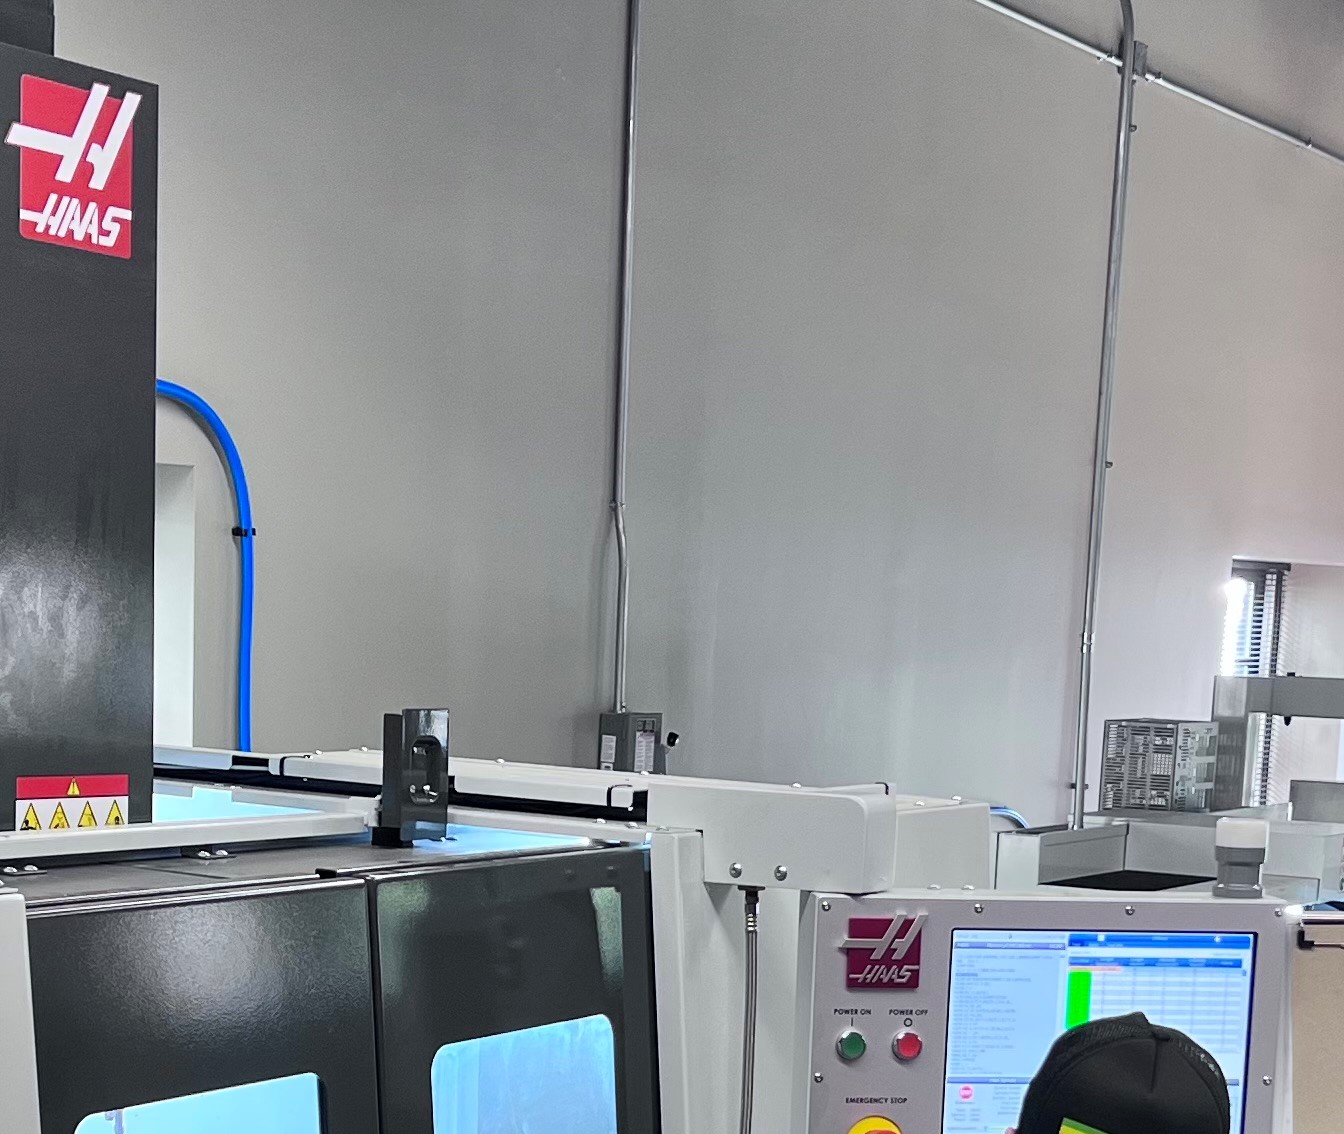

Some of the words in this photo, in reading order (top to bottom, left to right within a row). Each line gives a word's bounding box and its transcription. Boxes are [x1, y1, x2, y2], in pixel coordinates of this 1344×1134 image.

[20, 193, 132, 246] HAAS
[849, 965, 919, 983] HAAS
[833, 1008, 858, 1016] POWER
[860, 1008, 872, 1016] ON
[888, 1009, 913, 1017] POWER
[915, 1009, 928, 1017] OFF
[845, 1097, 888, 1105] EMERGENCY
[890, 1097, 908, 1105] STOP
